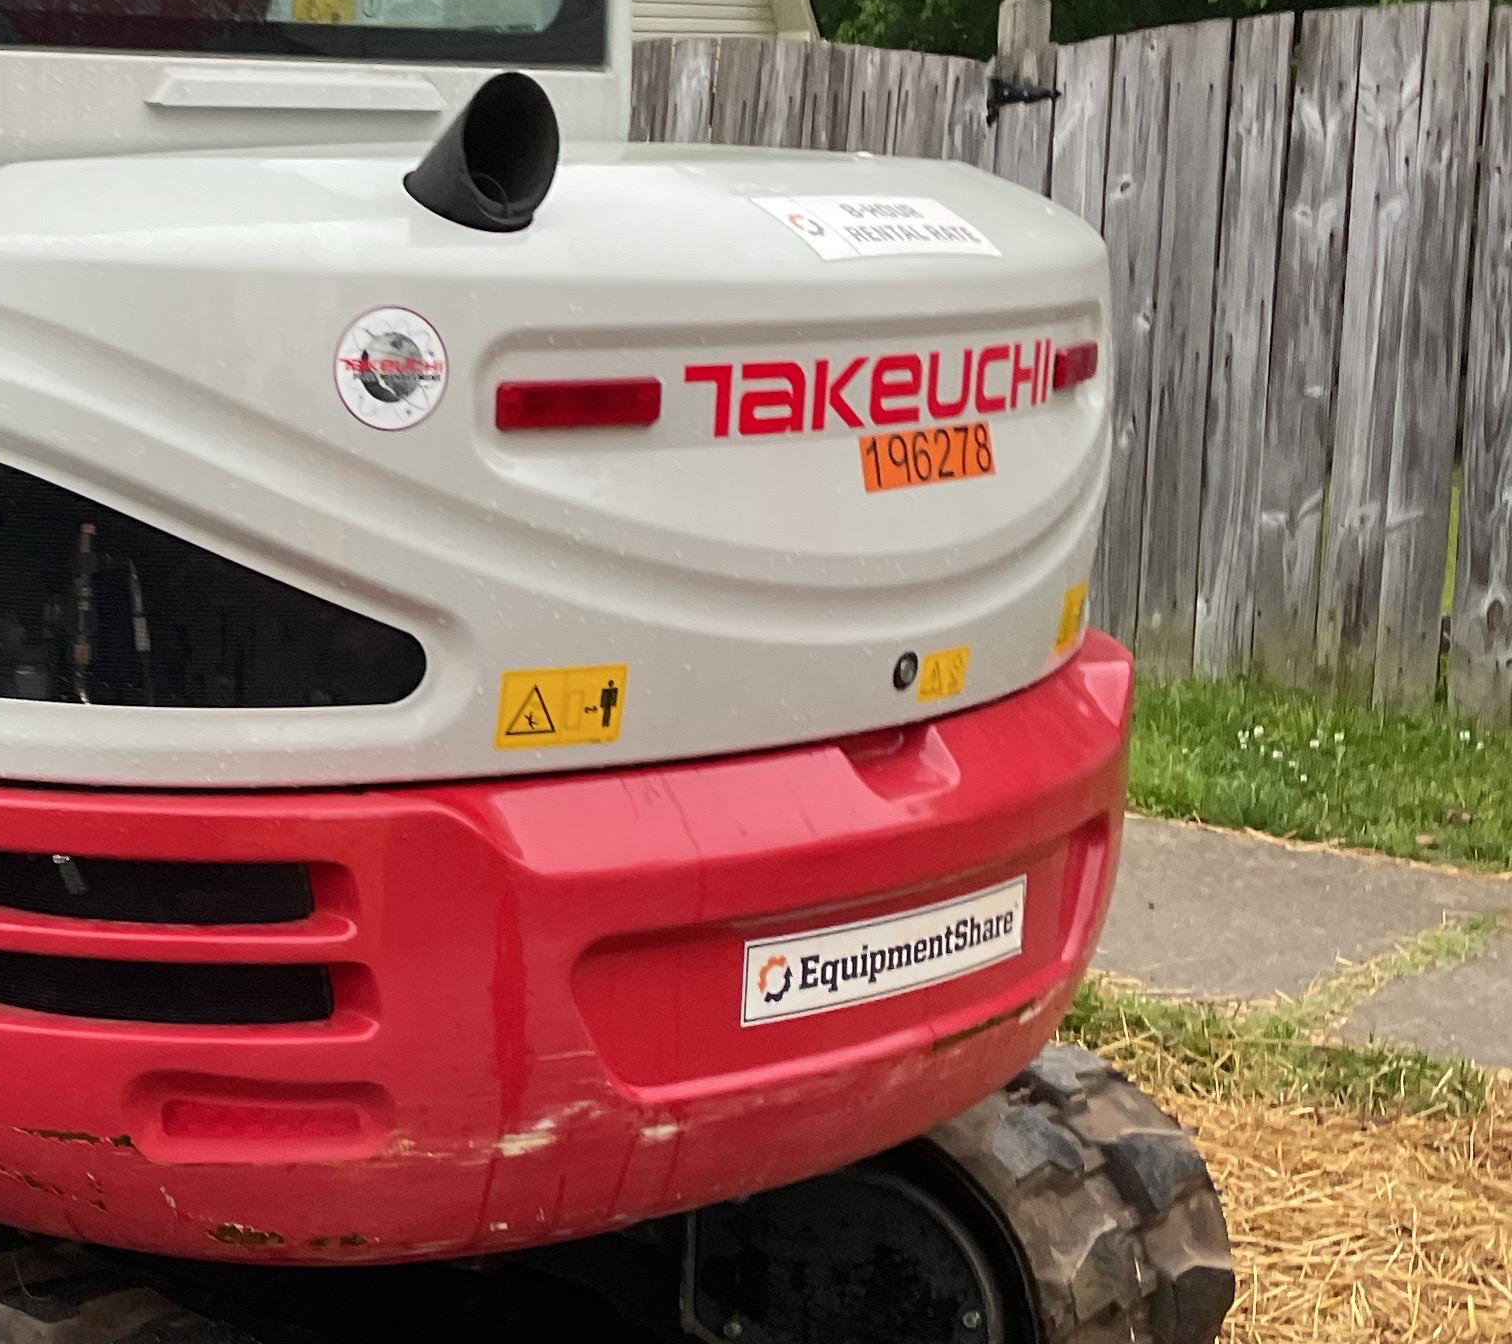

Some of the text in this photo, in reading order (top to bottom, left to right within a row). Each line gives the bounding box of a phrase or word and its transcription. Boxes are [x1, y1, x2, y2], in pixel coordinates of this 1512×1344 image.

[843, 225, 982, 244] RENTAL RATE
[684, 339, 1052, 438] TAKEUCHI
[865, 422, 993, 489] 196278
[798, 908, 1015, 994] EquipmentShare
